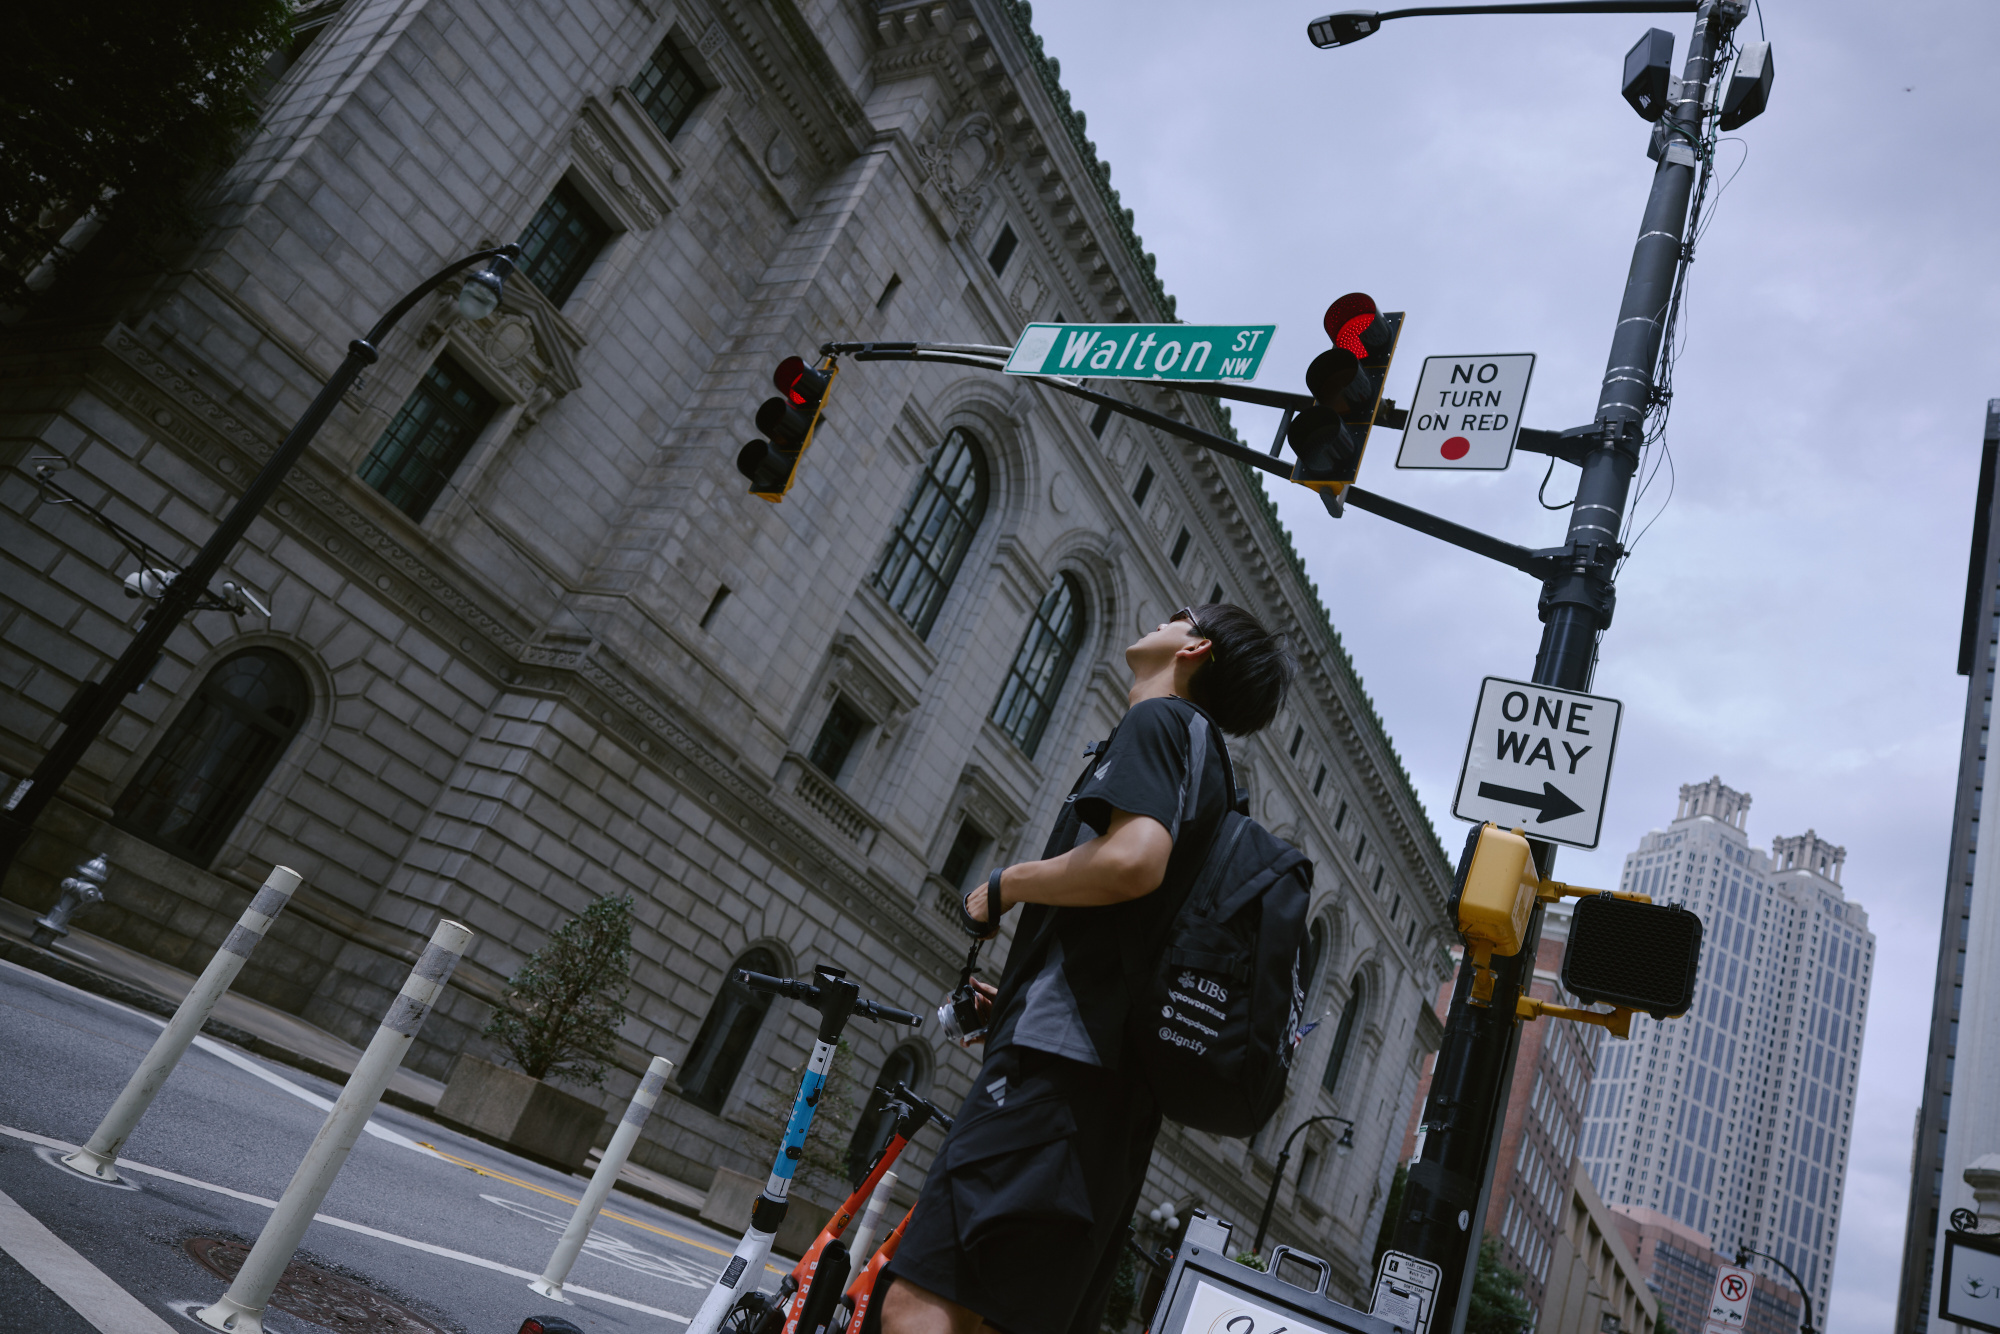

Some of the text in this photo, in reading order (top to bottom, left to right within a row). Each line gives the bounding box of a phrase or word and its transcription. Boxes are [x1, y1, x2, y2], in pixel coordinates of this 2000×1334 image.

[1058, 330, 1265, 372] Walton ST
[1218, 357, 1253, 376] NW
[1450, 363, 1499, 384] NO
[1439, 390, 1502, 407] TURN
[1417, 414, 1509, 431] ON RED
[1501, 690, 1594, 736] ONE
[1496, 728, 1593, 775] WAY
[1197, 977, 1229, 1003] UBS
[1172, 990, 1227, 1021] CROWDSTRIKE
[1175, 1012, 1219, 1038] Snapdragon
[1416, 1265, 1434, 1274] CROSSING
[796, 1260, 819, 1309] BIRD
[854, 1294, 870, 1329] BIRD
